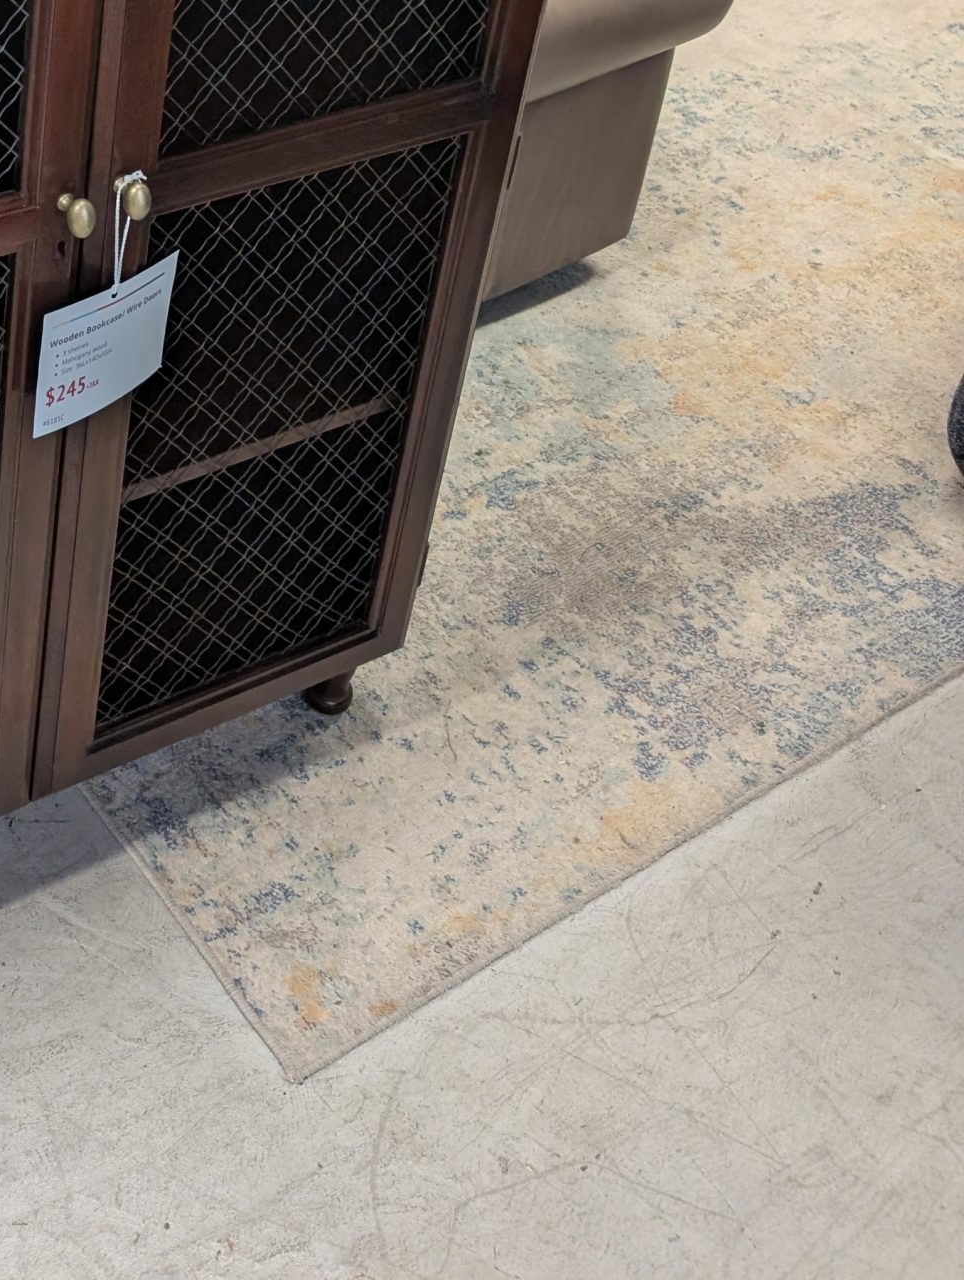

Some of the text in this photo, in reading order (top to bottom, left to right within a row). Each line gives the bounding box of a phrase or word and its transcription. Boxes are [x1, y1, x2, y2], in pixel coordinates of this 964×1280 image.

[49, 329, 85, 348] Wooden
[126, 300, 143, 316] Wire
[143, 288, 163, 305] Doors
[61, 340, 108, 366] Mahogany wood
[67, 342, 89, 355] shelves
